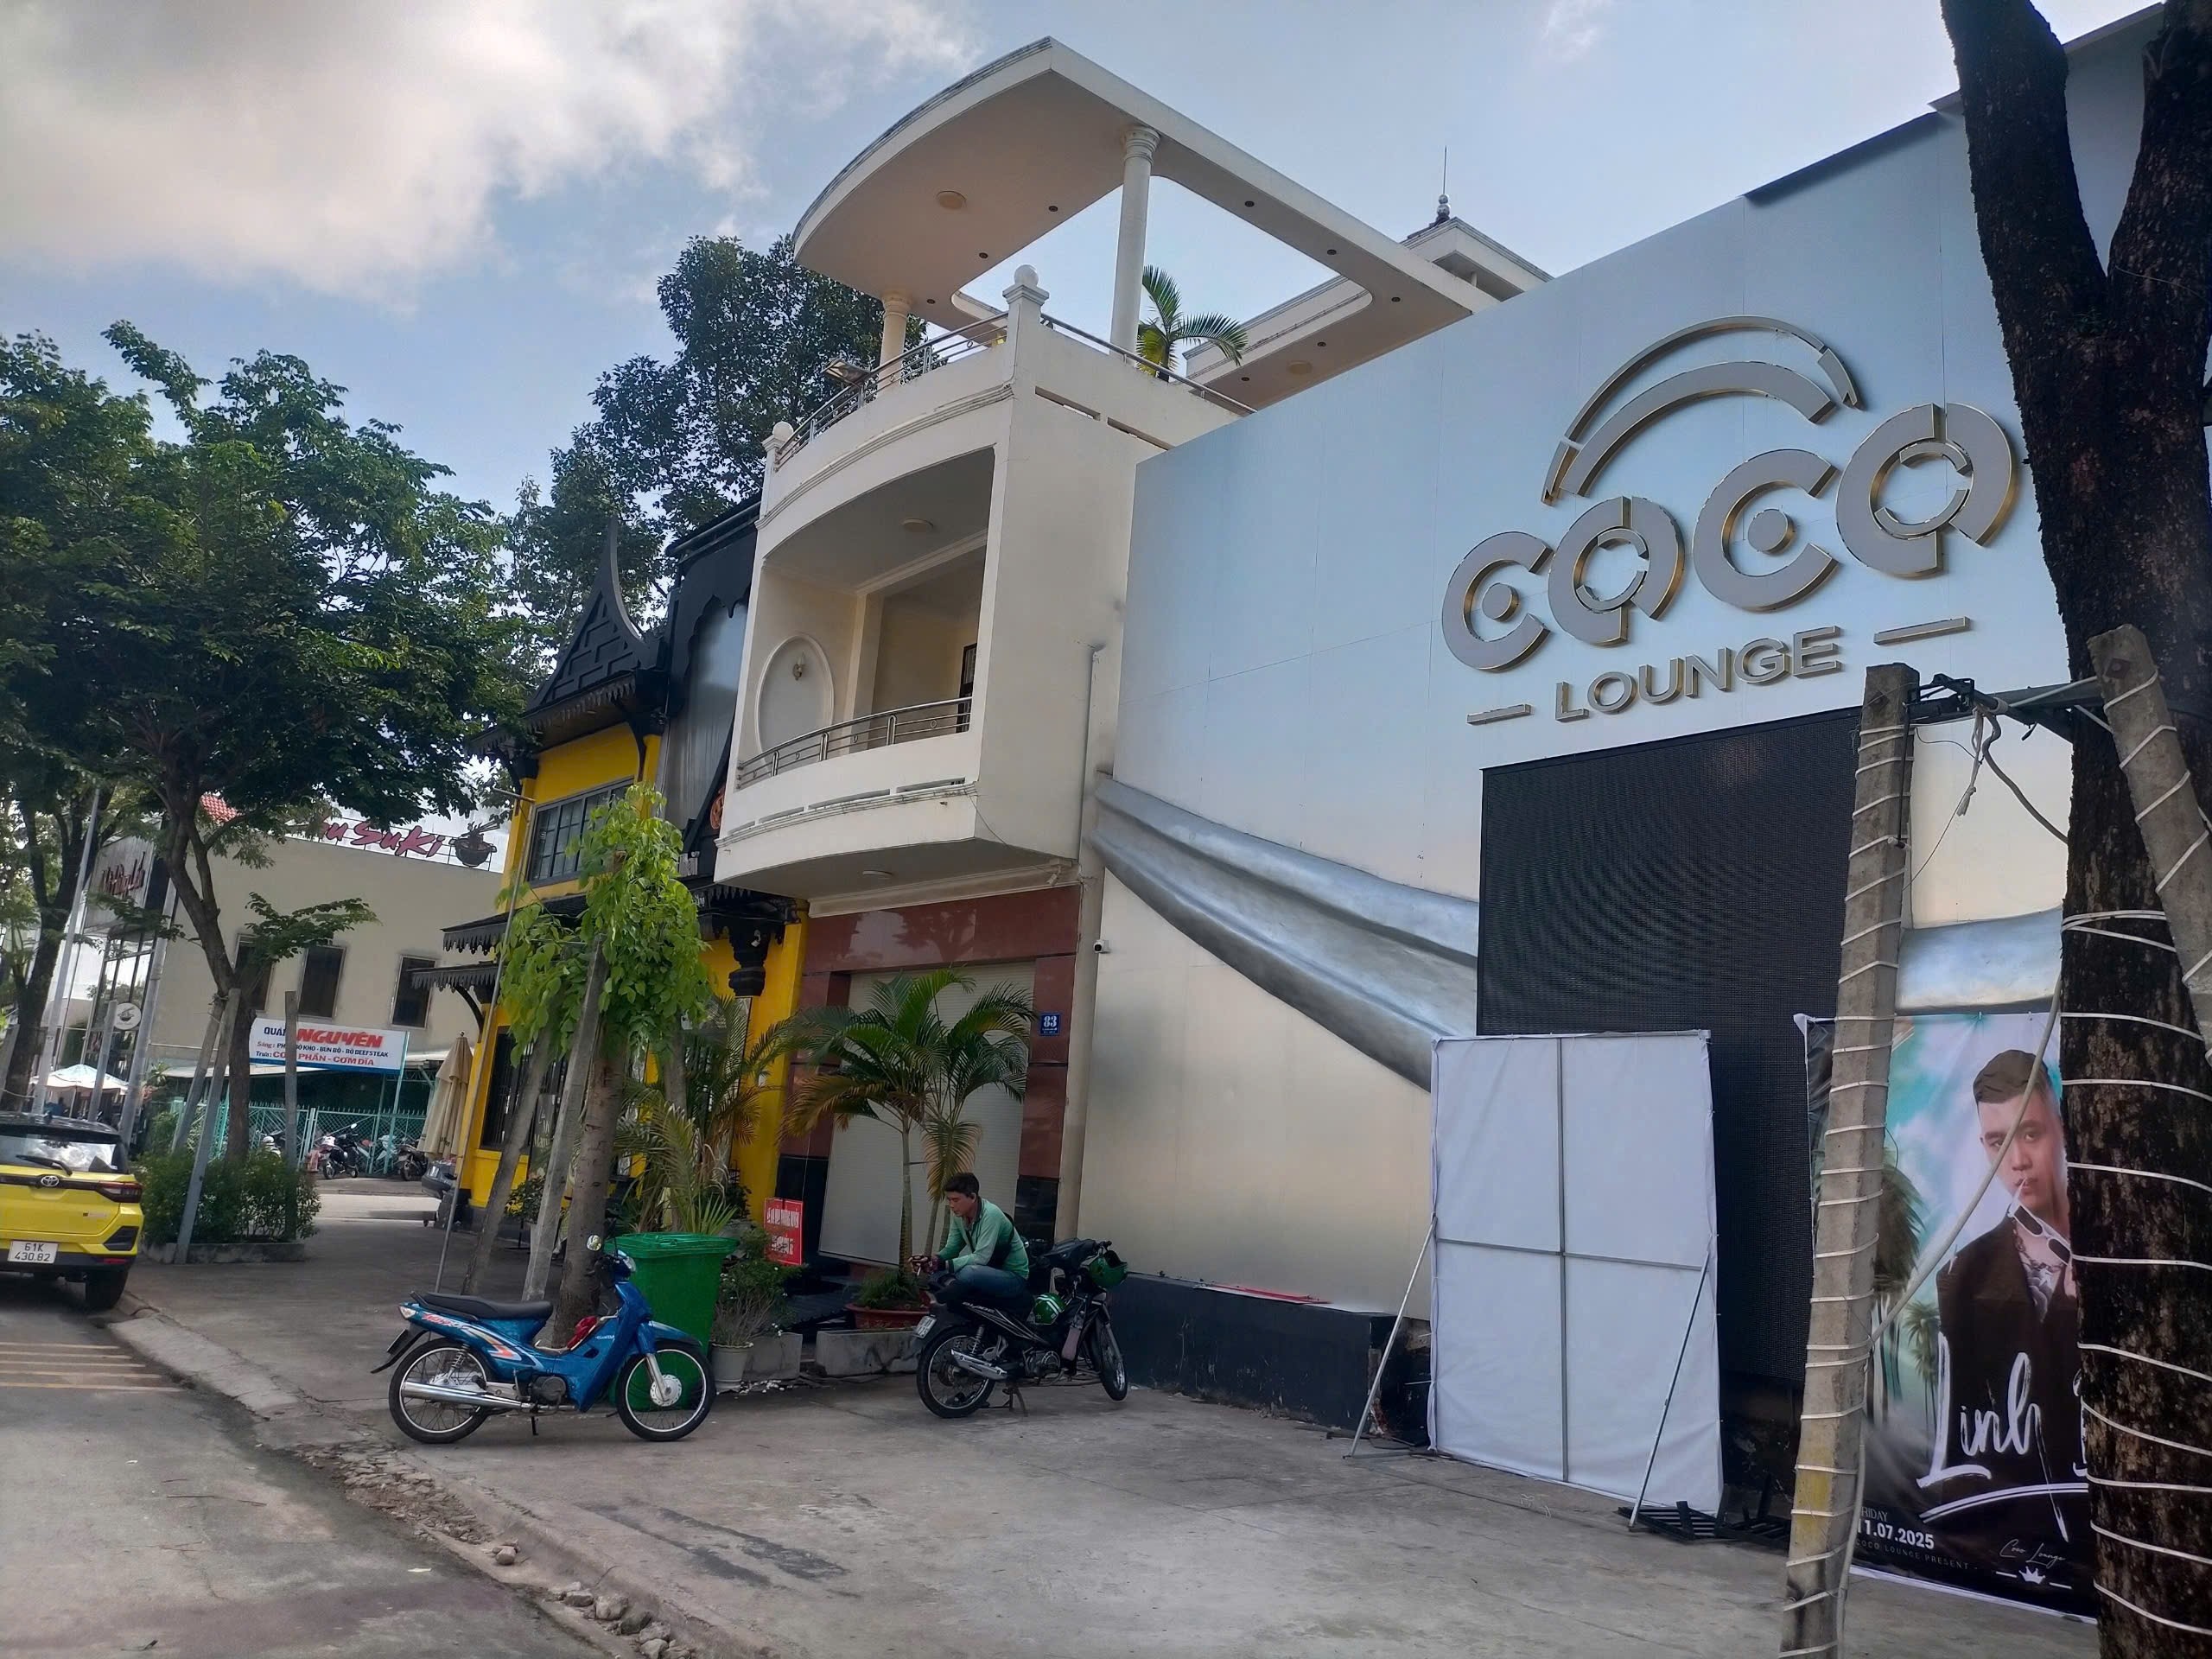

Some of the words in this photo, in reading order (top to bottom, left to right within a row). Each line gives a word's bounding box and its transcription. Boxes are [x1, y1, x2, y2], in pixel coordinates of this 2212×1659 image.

[1554, 625, 1845, 723] LOUNGE
[1043, 1015, 1058, 1027] 83
[354, 1048, 389, 1058] BEEFSTEAK
[24, 1243, 45, 1252] 61K
[14, 1252, 51, 1262] 430.82
[1916, 1331, 2069, 1542] Linh
[1860, 1505, 1889, 1523] RIDAY
[1925, 1554, 1969, 1570] PRESENT
